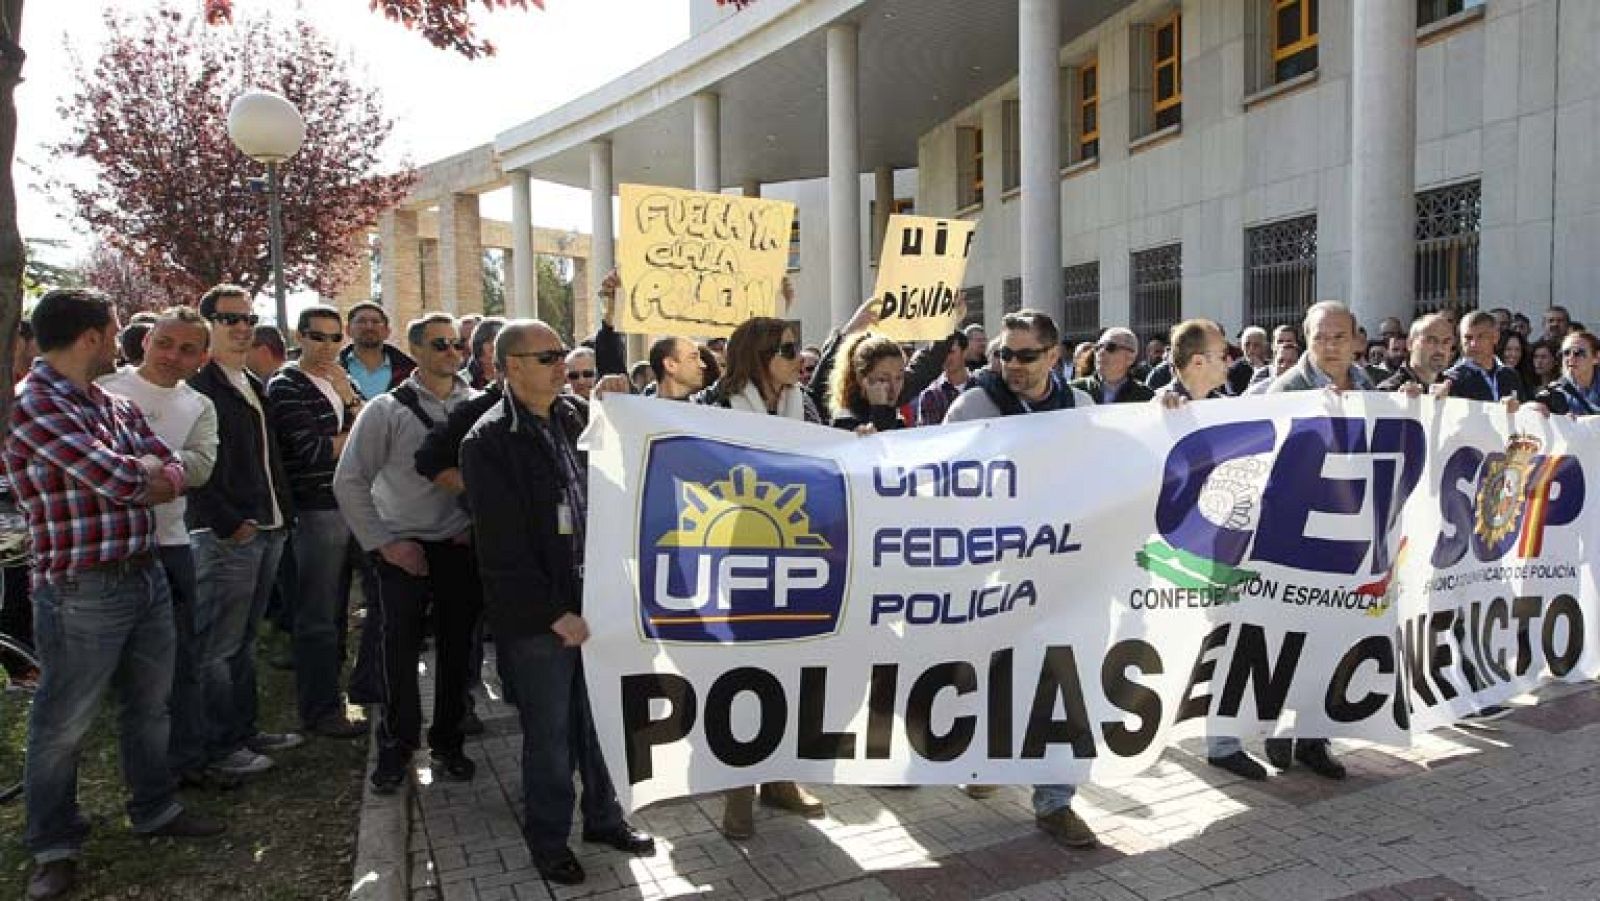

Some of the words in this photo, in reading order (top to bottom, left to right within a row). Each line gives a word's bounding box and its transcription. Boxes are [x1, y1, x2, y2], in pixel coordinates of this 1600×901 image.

[879, 281, 959, 319] DIGNID
[872, 523, 1082, 568] FEDERAL
[653, 553, 831, 610] UFP
[1130, 576, 1278, 611] CONFEDEIÓN
[1176, 623, 1307, 725] EN
